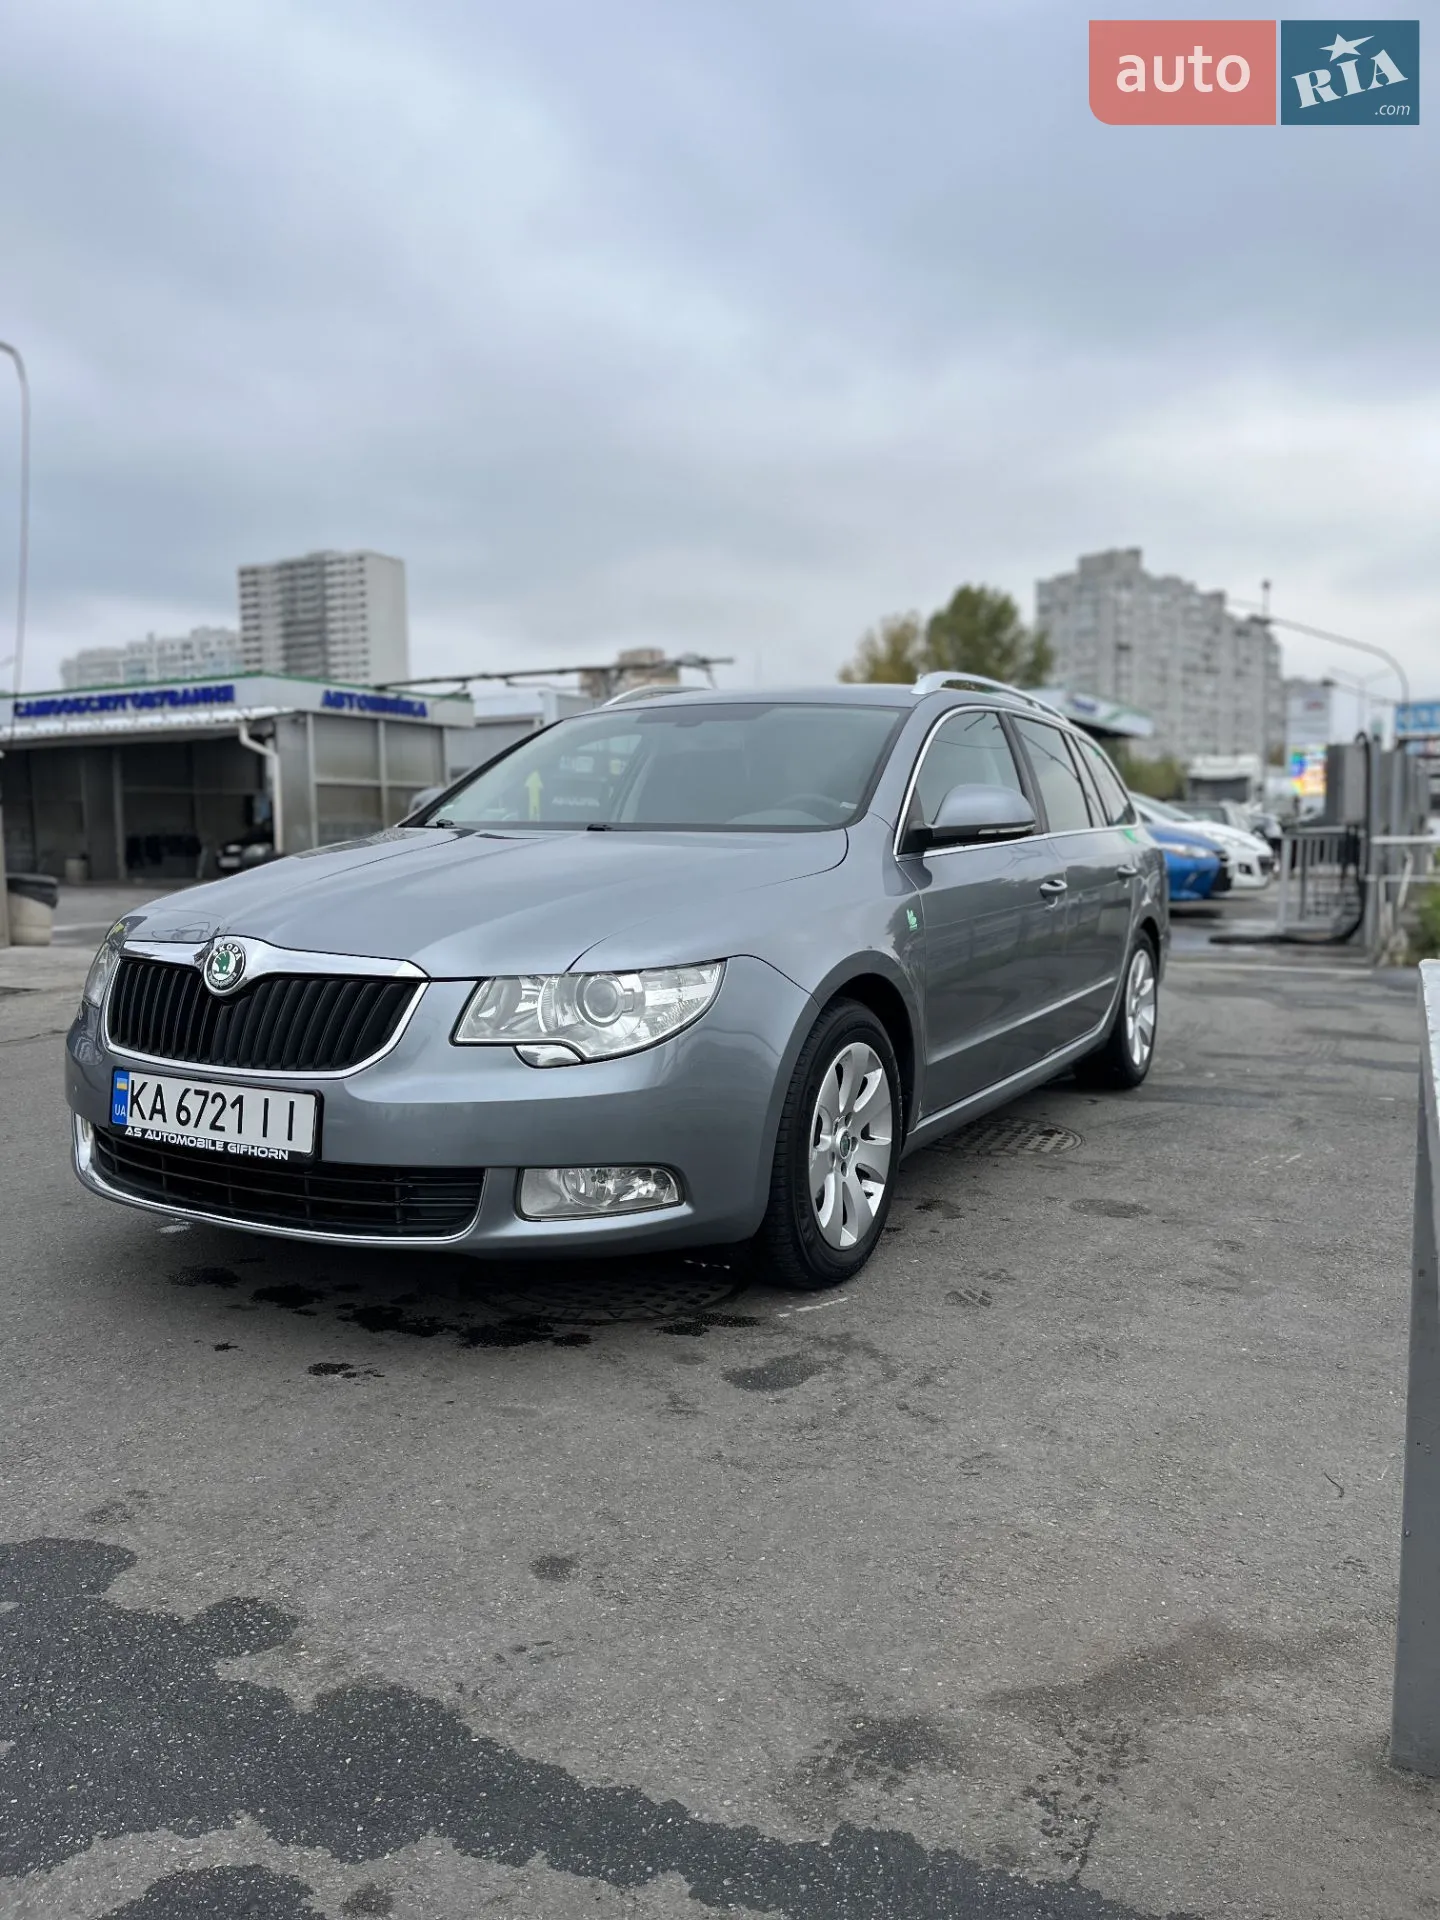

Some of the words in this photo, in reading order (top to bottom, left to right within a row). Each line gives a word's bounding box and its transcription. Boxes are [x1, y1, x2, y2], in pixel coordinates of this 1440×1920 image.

[114, 1104, 126, 1117] UA
[129, 1079, 167, 1124] KA
[176, 1088, 245, 1135] 6721
[262, 1097, 296, 1142] II
[125, 1126, 142, 1138] AS
[145, 1129, 224, 1152] AUTOMOBILE
[227, 1143, 289, 1161] GIFHORN
